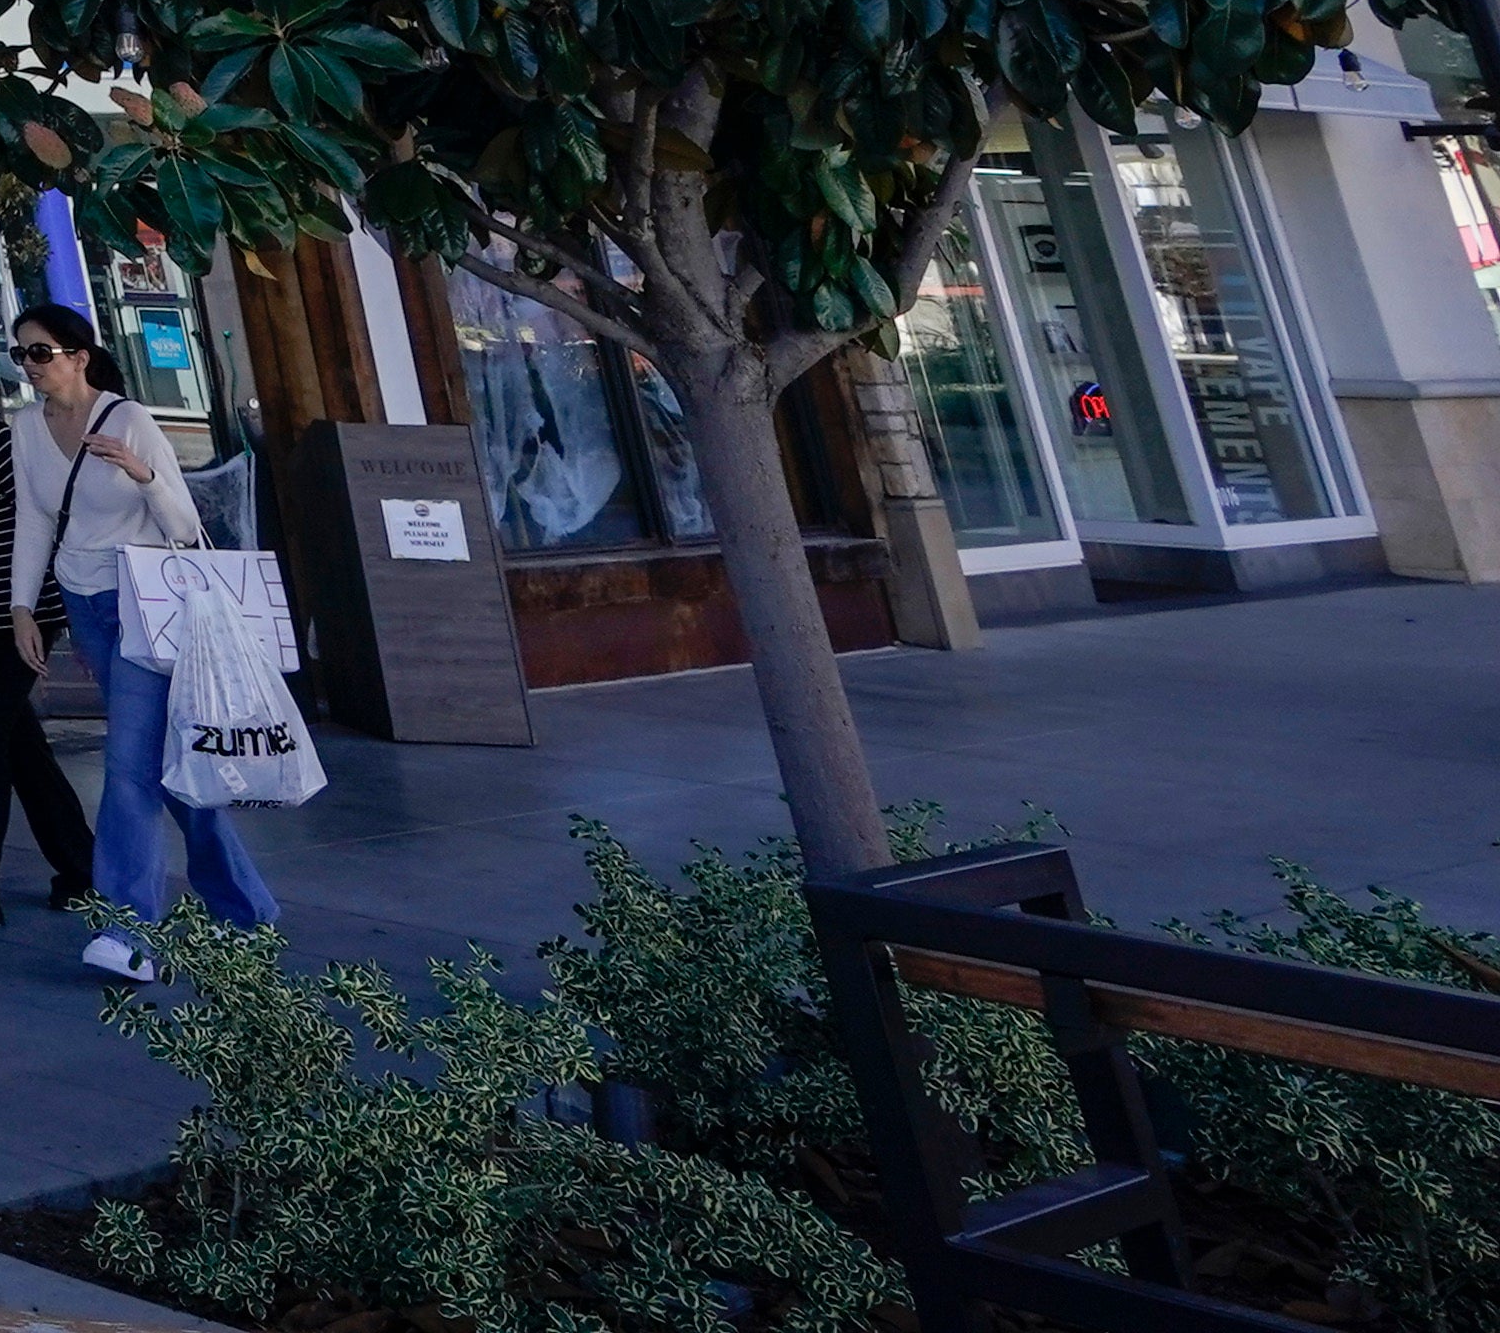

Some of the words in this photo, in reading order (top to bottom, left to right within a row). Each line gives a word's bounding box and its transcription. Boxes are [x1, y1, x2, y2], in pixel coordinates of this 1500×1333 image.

[1237, 337, 1291, 426] VAPE
[361, 459, 466, 475] WELCOME
[192, 721, 297, 758] zumie
